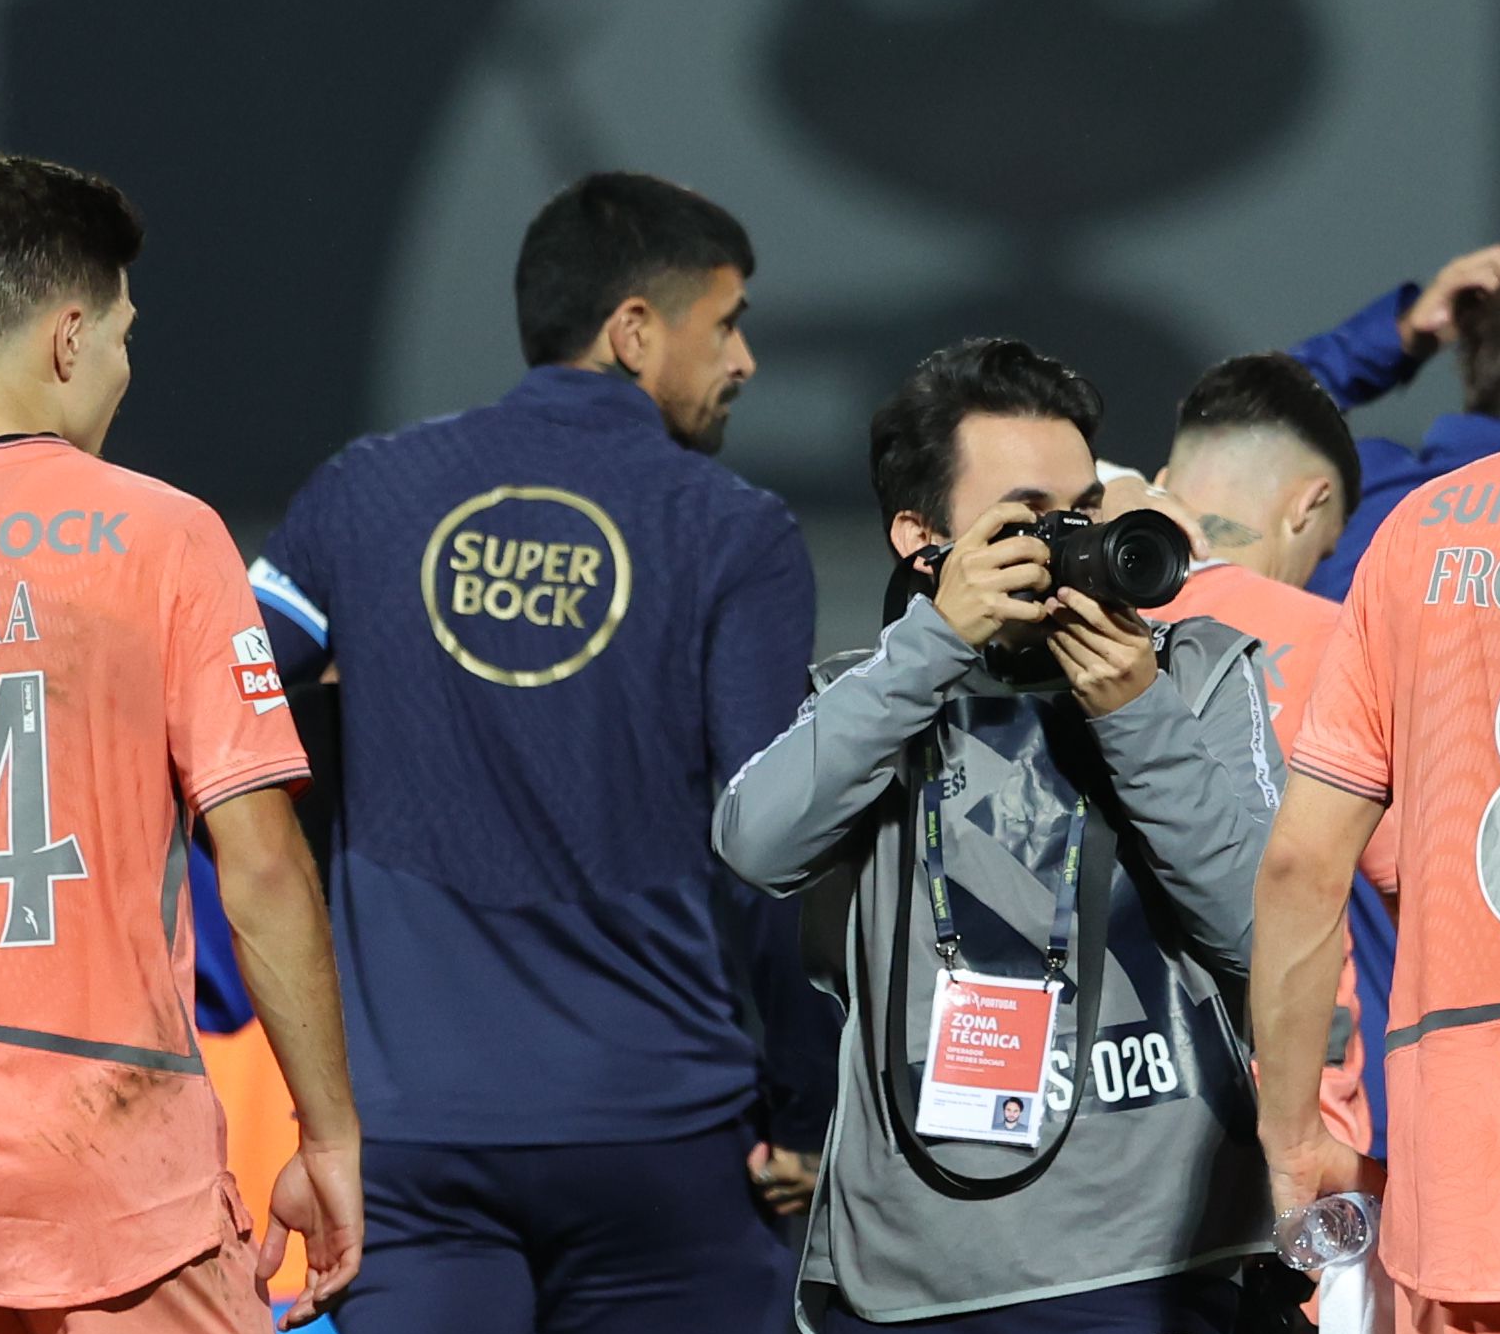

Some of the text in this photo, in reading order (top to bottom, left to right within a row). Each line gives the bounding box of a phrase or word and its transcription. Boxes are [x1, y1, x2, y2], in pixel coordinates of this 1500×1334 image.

[1063, 517, 1089, 526] SONY
[450, 531, 601, 587] SUPER
[452, 575, 588, 629] BOCK
[950, 1026, 1020, 1049] TÉCNICA
[951, 1013, 998, 1031] ZONA
[1090, 1032, 1177, 1104] 028
